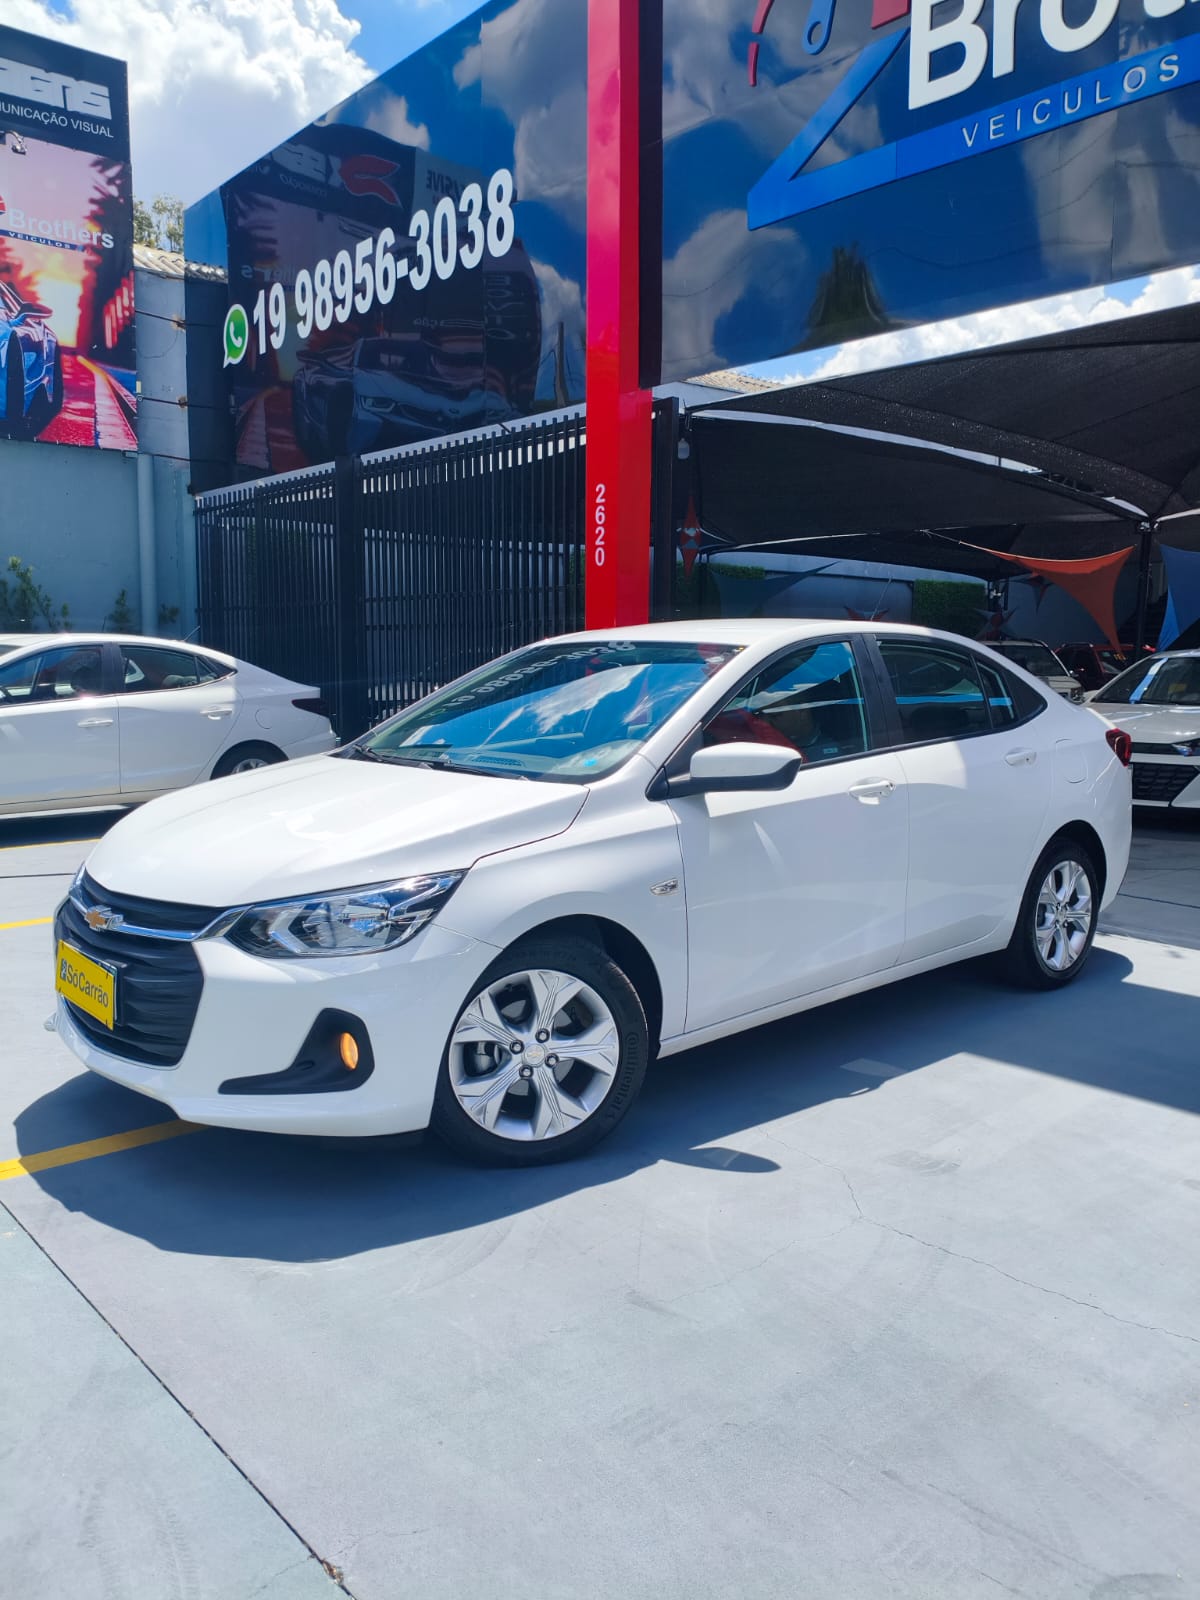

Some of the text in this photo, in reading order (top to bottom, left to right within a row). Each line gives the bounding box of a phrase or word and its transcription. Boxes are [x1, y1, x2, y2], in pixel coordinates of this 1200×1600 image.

[909, 0, 1200, 110] Bro
[0, 101, 114, 138] UNICAÇÃO VISUAL
[961, 54, 1180, 149] VEICULOS
[8, 207, 115, 249] Brothers
[8, 231, 71, 249] VEICULOS
[253, 281, 287, 355] 19
[294, 168, 516, 339] 98956-3038
[595, 483, 607, 567] 2620
